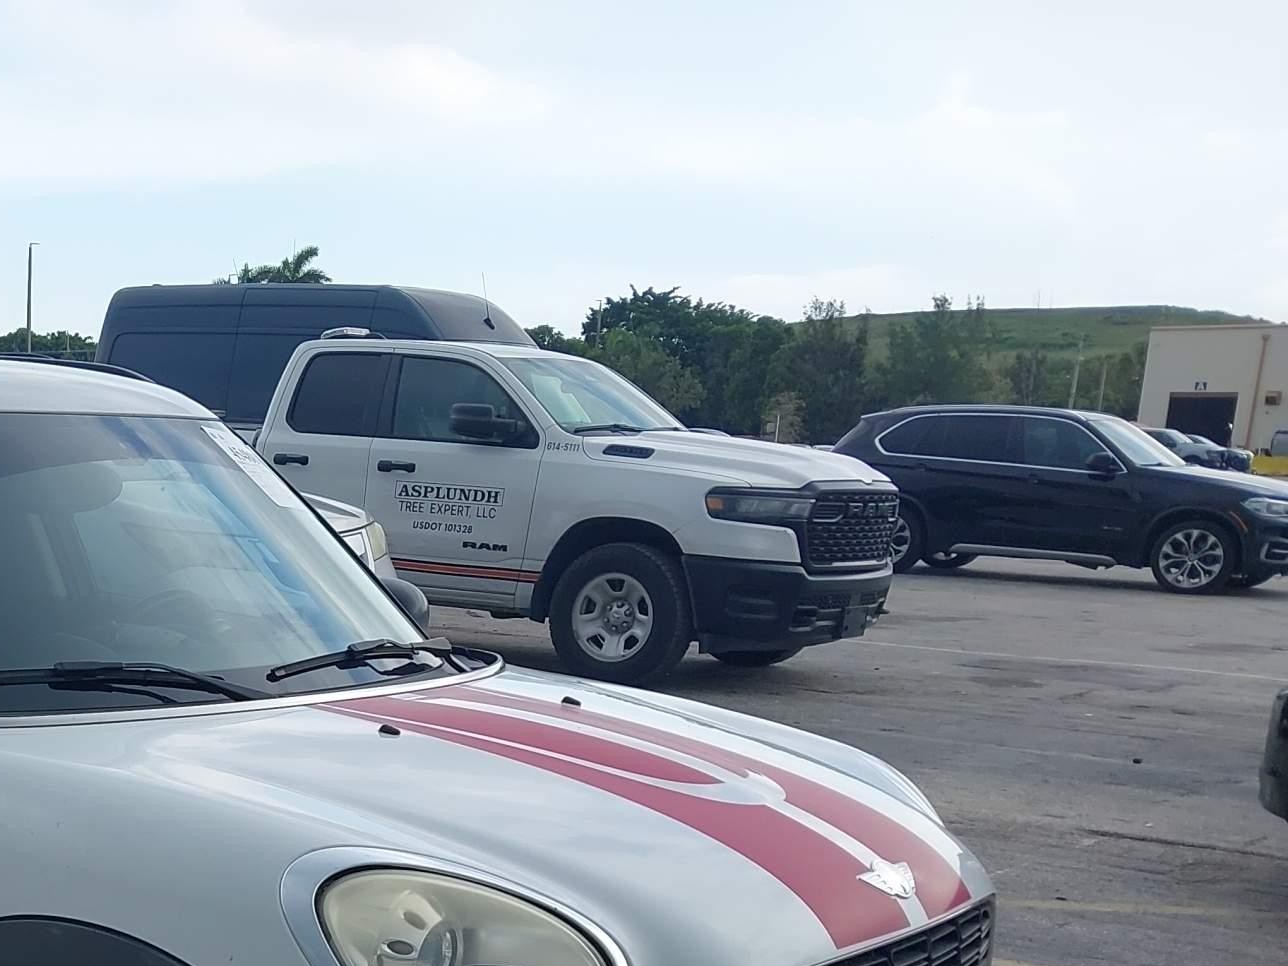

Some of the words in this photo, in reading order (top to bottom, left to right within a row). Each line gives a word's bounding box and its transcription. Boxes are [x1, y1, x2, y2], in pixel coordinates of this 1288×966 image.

[398, 484, 500, 504] ASPLUNDH
[399, 500, 425, 513] TREE
[430, 503, 472, 518] EXPERT,
[476, 507, 497, 519] LLC
[412, 520, 443, 532] USDOT
[444, 523, 473, 534] 101328
[462, 541, 508, 552] RAM
